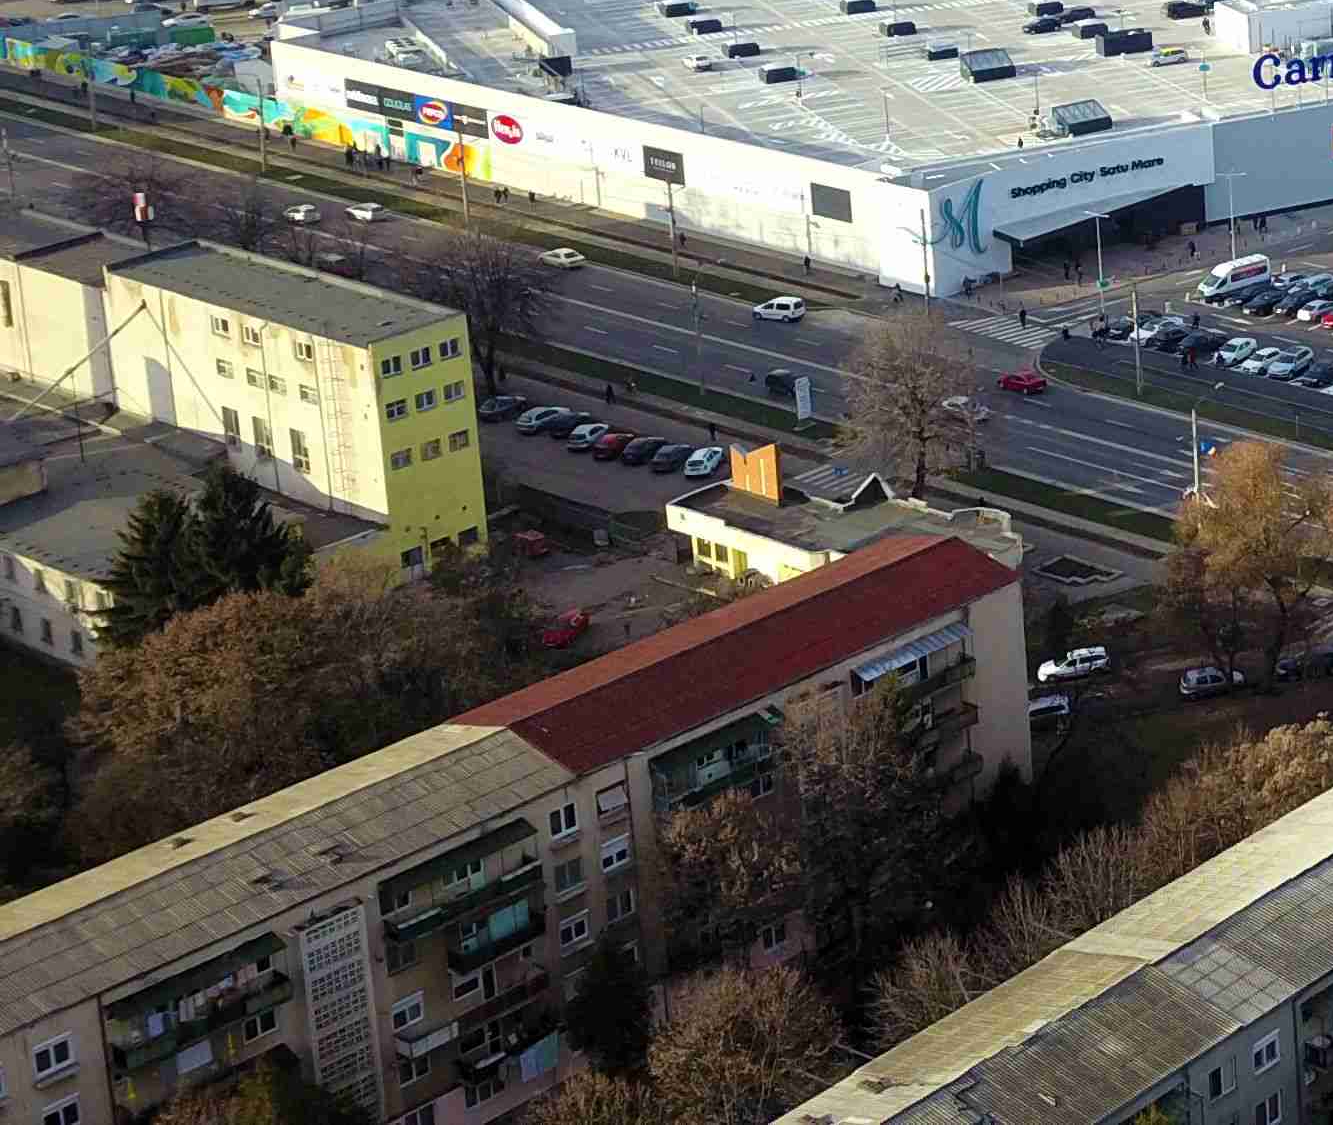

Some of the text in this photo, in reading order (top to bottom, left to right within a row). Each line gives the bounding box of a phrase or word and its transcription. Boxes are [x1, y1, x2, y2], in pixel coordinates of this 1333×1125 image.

[1010, 156, 1165, 199] Shopping City Satu Mare
